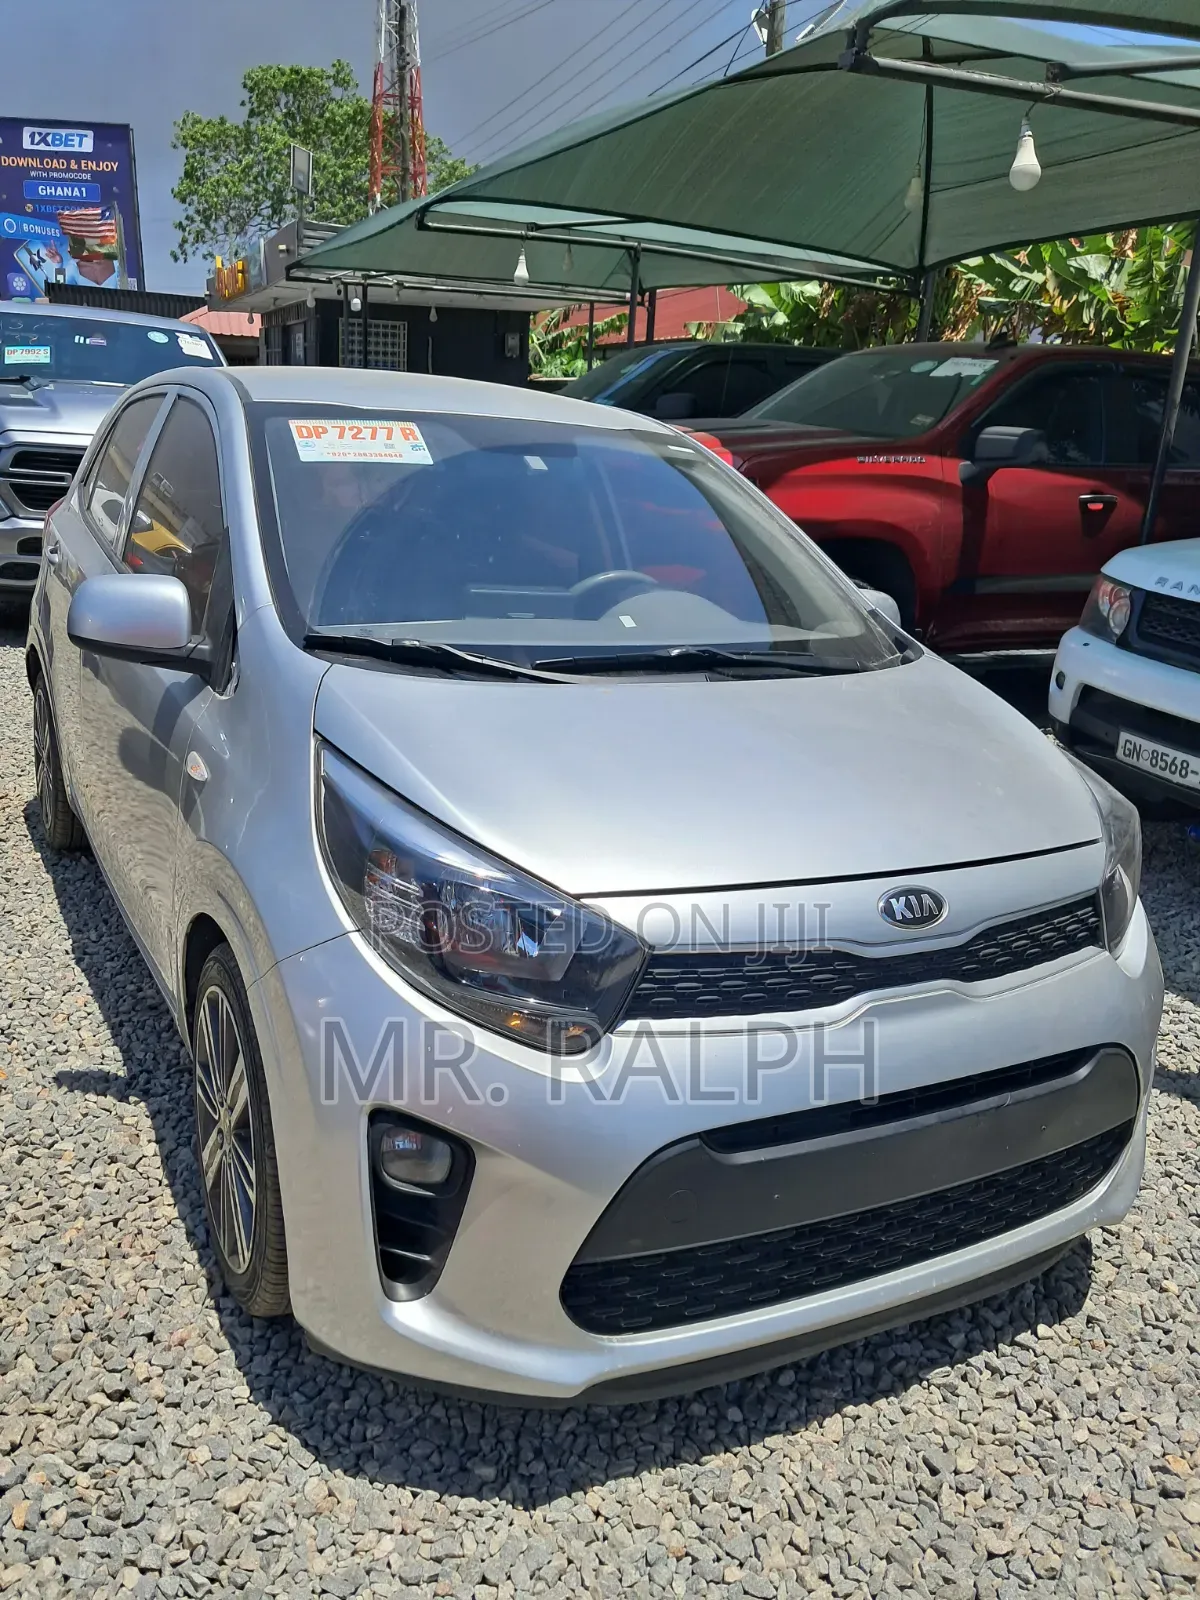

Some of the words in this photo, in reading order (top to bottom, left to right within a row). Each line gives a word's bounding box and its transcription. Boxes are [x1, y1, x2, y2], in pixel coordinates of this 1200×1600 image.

[28, 131, 88, 149] 1XBET
[1, 156, 67, 169] DOWNLOAD
[70, 159, 78, 170] &
[81, 160, 118, 172] ENJOY
[49, 172, 92, 180] PROMOCODE
[38, 186, 86, 197] GHANA1
[23, 224, 60, 237] BONUSES
[295, 425, 329, 439] DP
[331, 425, 394, 440] 7277
[399, 427, 420, 441] R
[1122, 739, 1142, 762] GN
[889, 893, 939, 920] KIA
